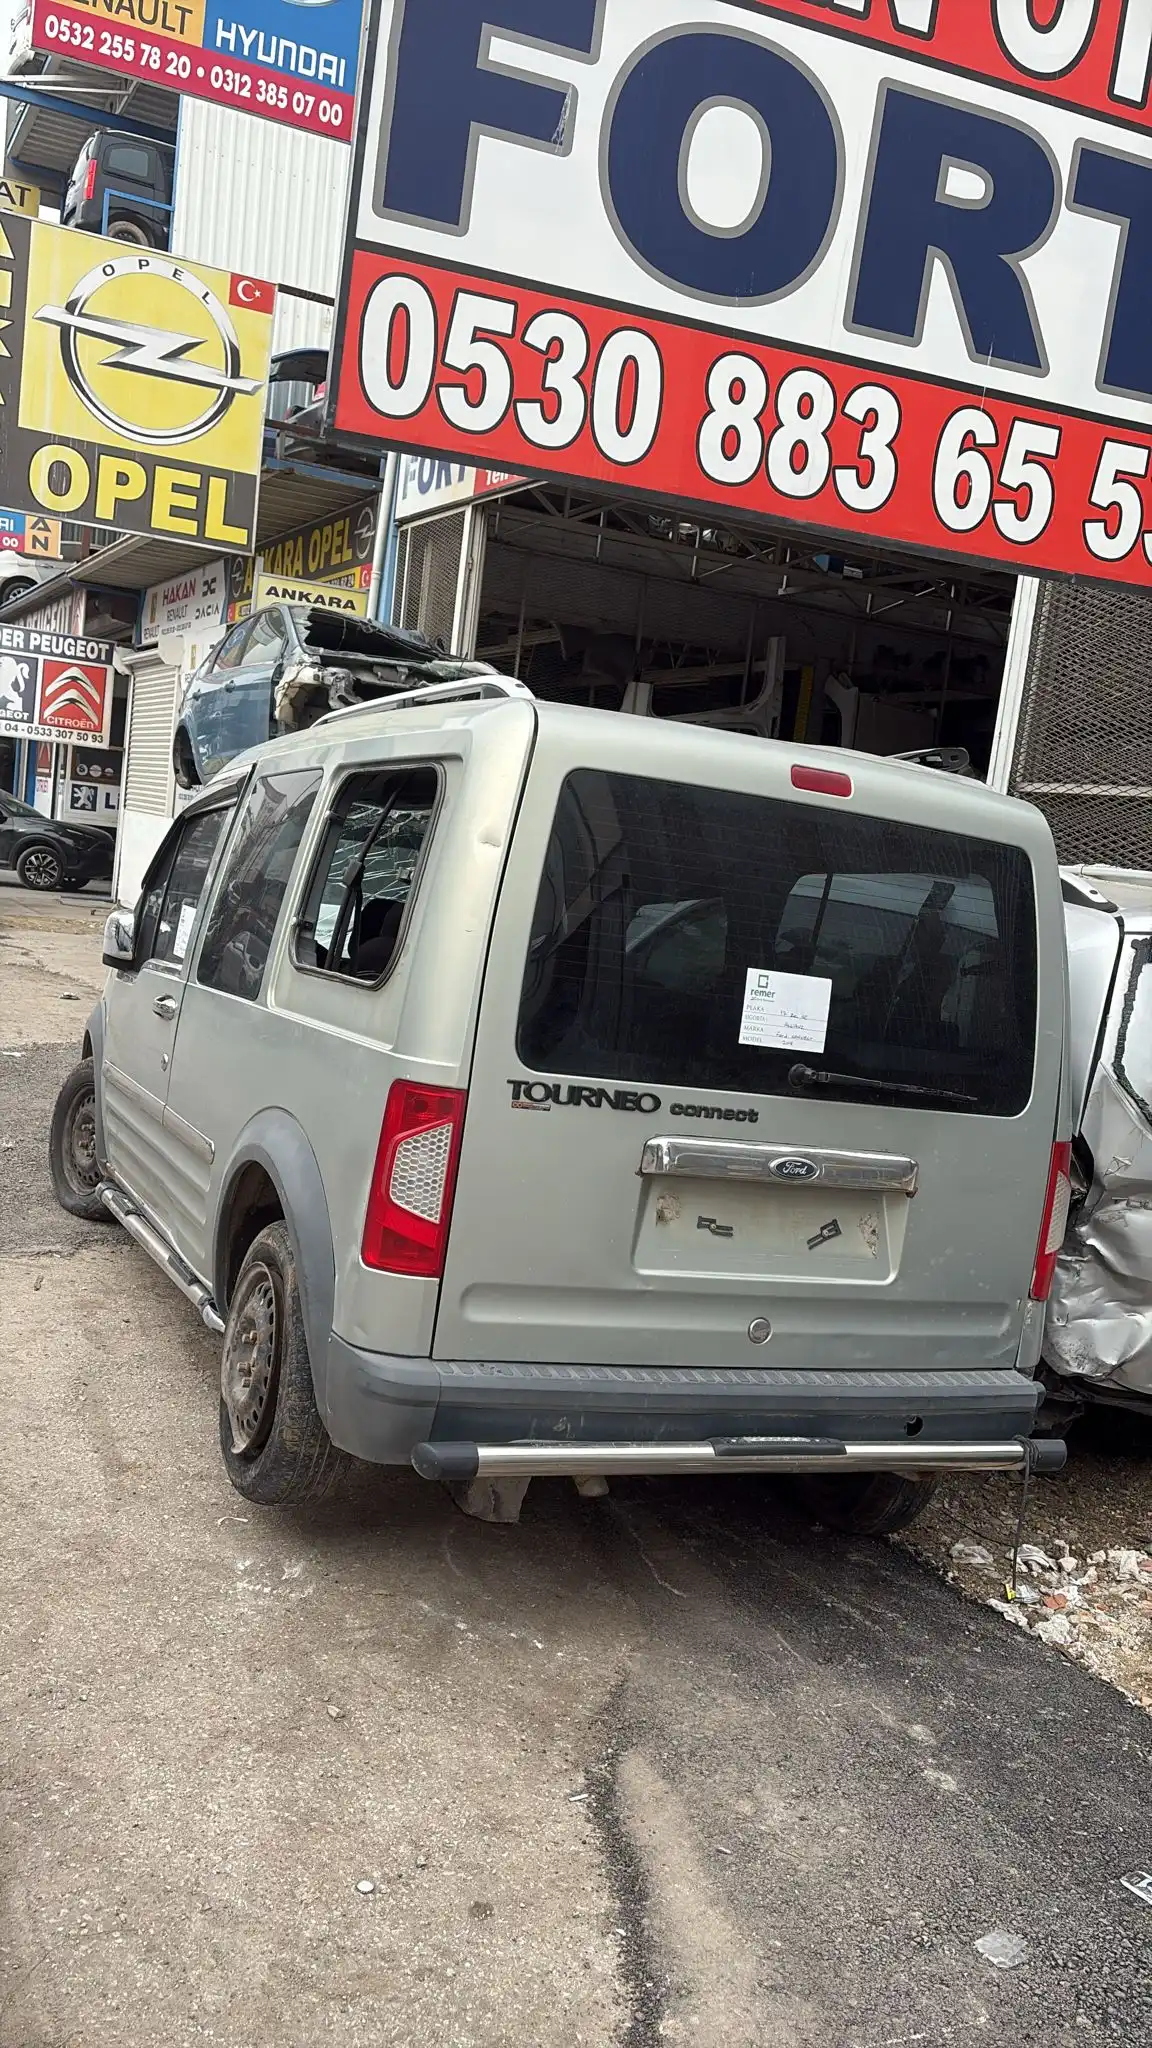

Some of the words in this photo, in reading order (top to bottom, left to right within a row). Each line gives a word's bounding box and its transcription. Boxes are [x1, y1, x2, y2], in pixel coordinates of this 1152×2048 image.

[44, 15, 95, 50] 0532
[99, 31, 135, 62] 255
[140, 43, 161, 70] 78
[165, 52, 191, 79] 20
[210, 65, 252, 98] 0312
[255, 79, 288, 109] 385
[292, 91, 315, 117] 07
[318, 100, 343, 126] 00
[216, 18, 346, 87] HYUNDAI
[102, 258, 213, 305] OPEL
[358, 272, 665, 465] 0530
[697, 351, 903, 514] 883
[931, 406, 1063, 546] 65
[1082, 437, 1152, 567] 5
[29, 444, 249, 546] OPEL
[307, 517, 353, 573] OPEL
[163, 577, 197, 606] HAKAN
[265, 586, 356, 611] ANKARA
[0, 628, 24, 649] ER
[29, 632, 109, 661] PEUGEOT
[5, 722, 19, 733] 04
[27, 725, 52, 737] 0533
[55, 729, 74, 740] 307
[76, 732, 89, 742] 50
[92, 734, 103, 744] 93
[750, 989, 775, 999] remer
[507, 1079, 661, 1113] TOURNEO
[669, 1101, 759, 1123] connect
[782, 1161, 807, 1175] Ford
